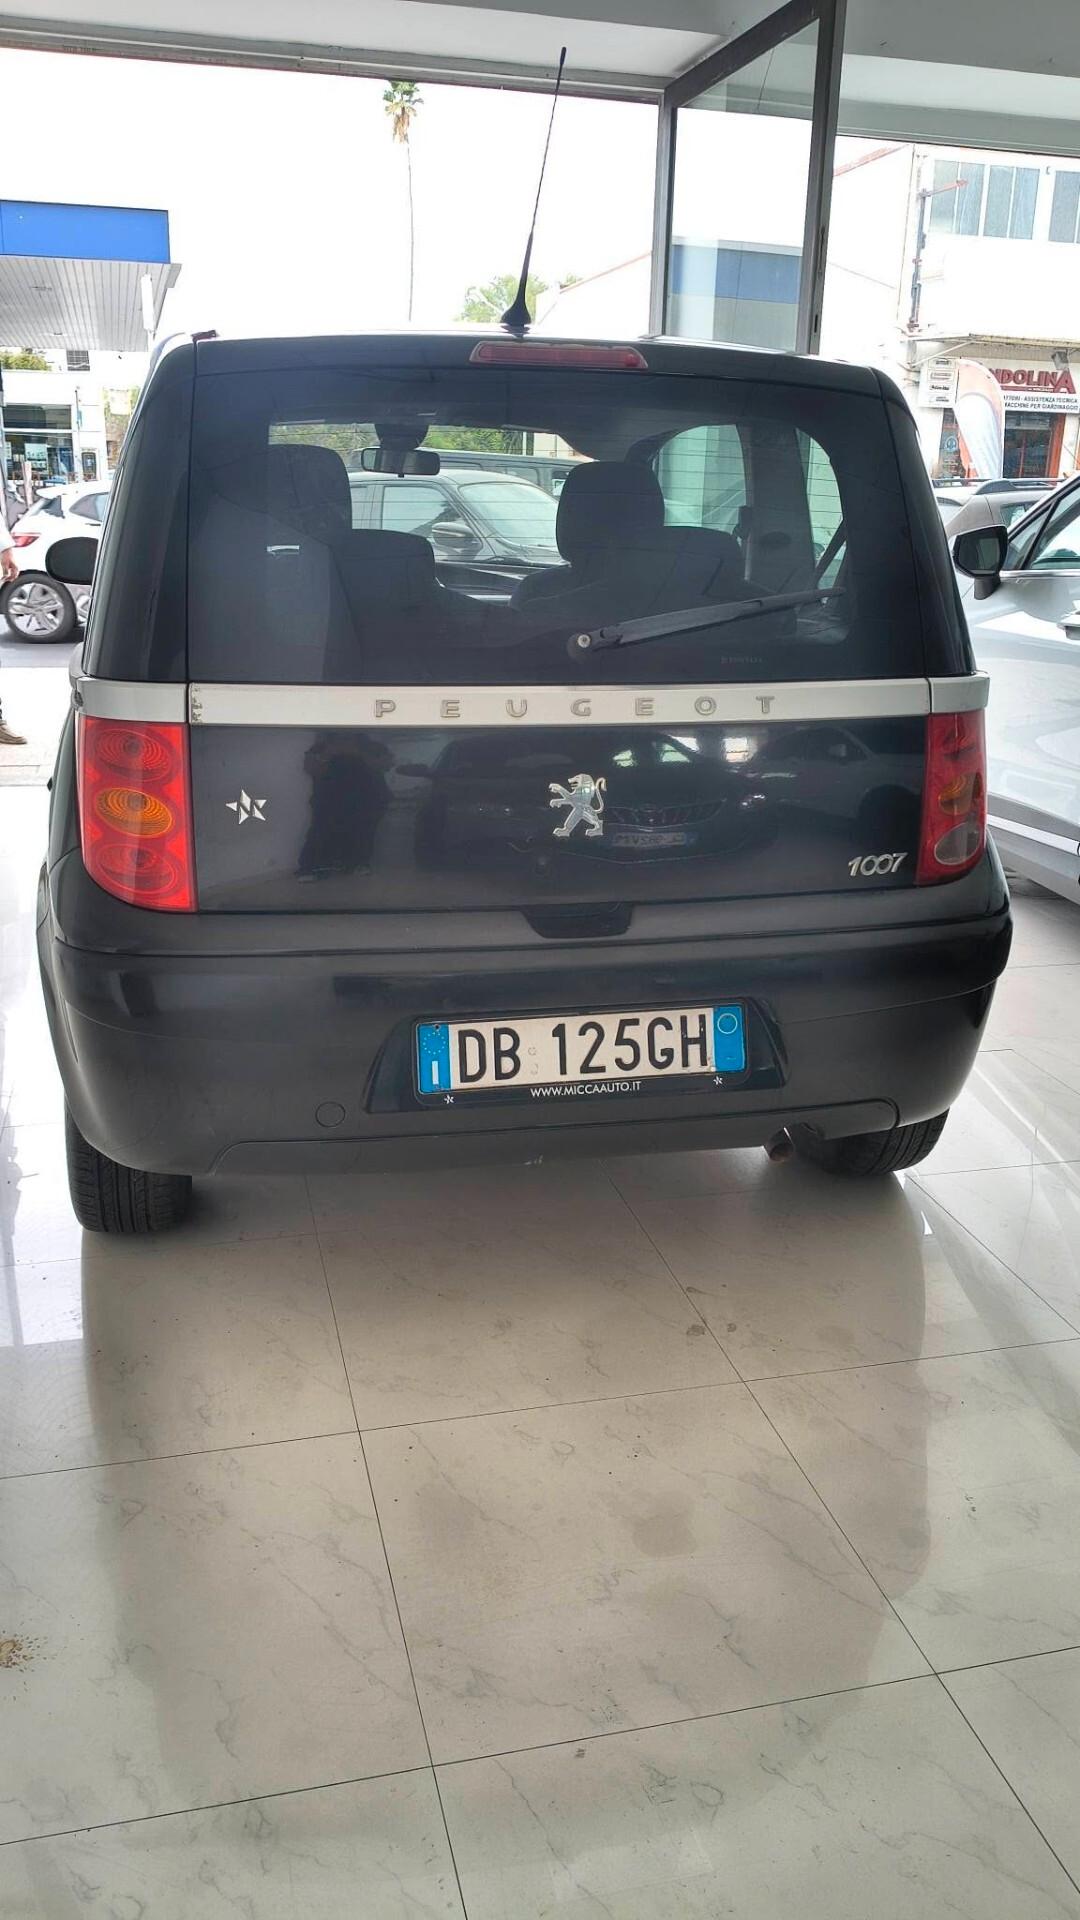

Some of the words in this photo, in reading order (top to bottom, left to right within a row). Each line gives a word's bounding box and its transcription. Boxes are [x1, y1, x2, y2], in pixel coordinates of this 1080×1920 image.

[375, 696, 775, 718] PEUGEOT
[848, 852, 908, 877] 1007
[457, 1027, 521, 1084] DB
[551, 1014, 708, 1076] 125GH
[530, 1080, 641, 1098] WWW.MICCAAUTO.IT
